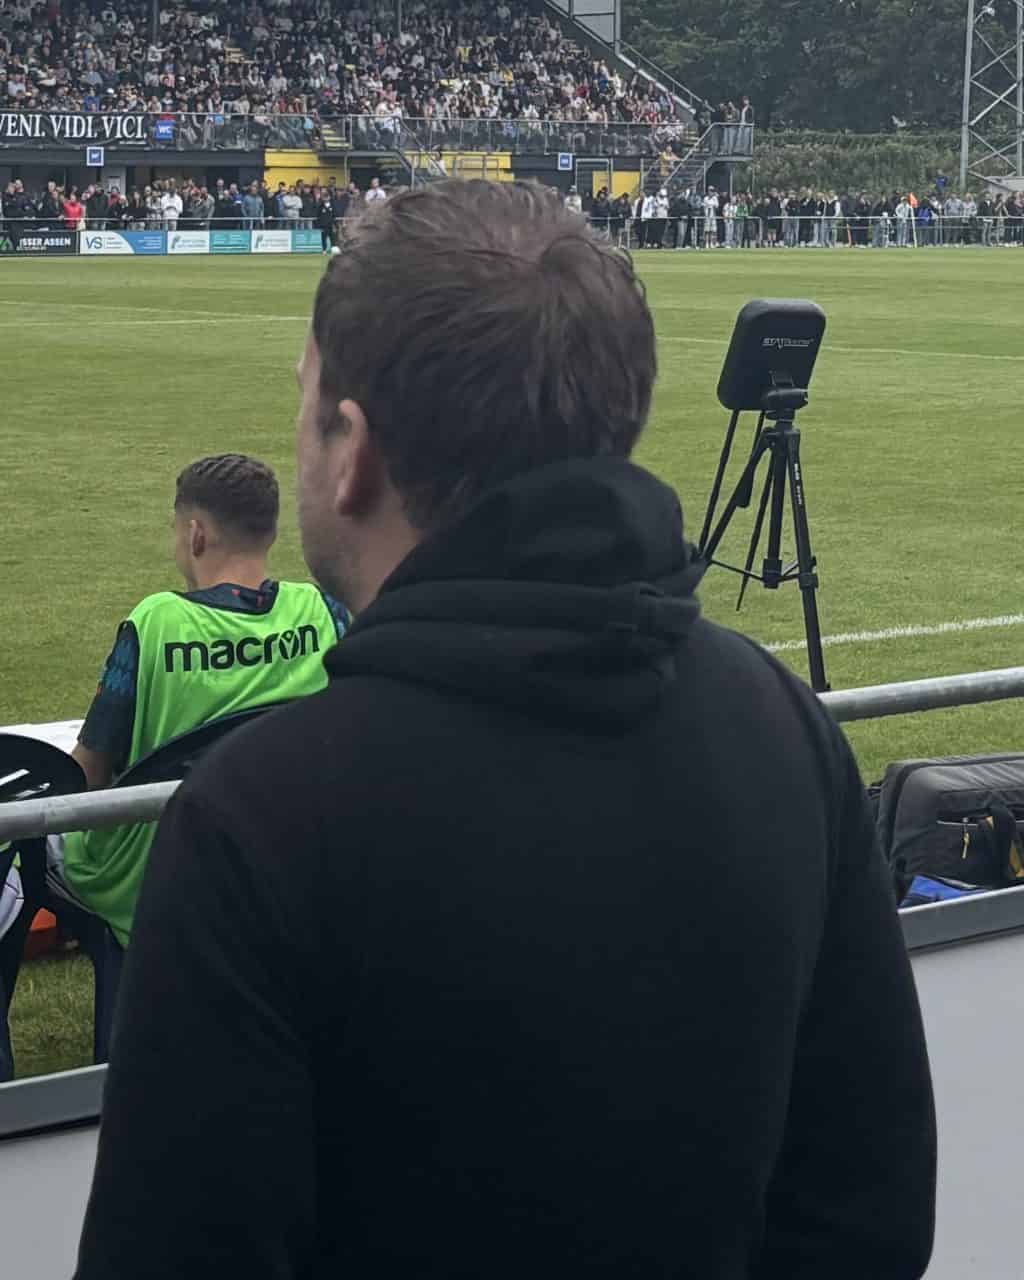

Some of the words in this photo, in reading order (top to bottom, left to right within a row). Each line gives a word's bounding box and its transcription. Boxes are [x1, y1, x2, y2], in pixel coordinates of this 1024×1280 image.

[50, 114, 98, 138] VIDI.
[102, 115, 147, 138] VICI.
[44, 236, 71, 247] ASSEN
[164, 624, 320, 672] macron
